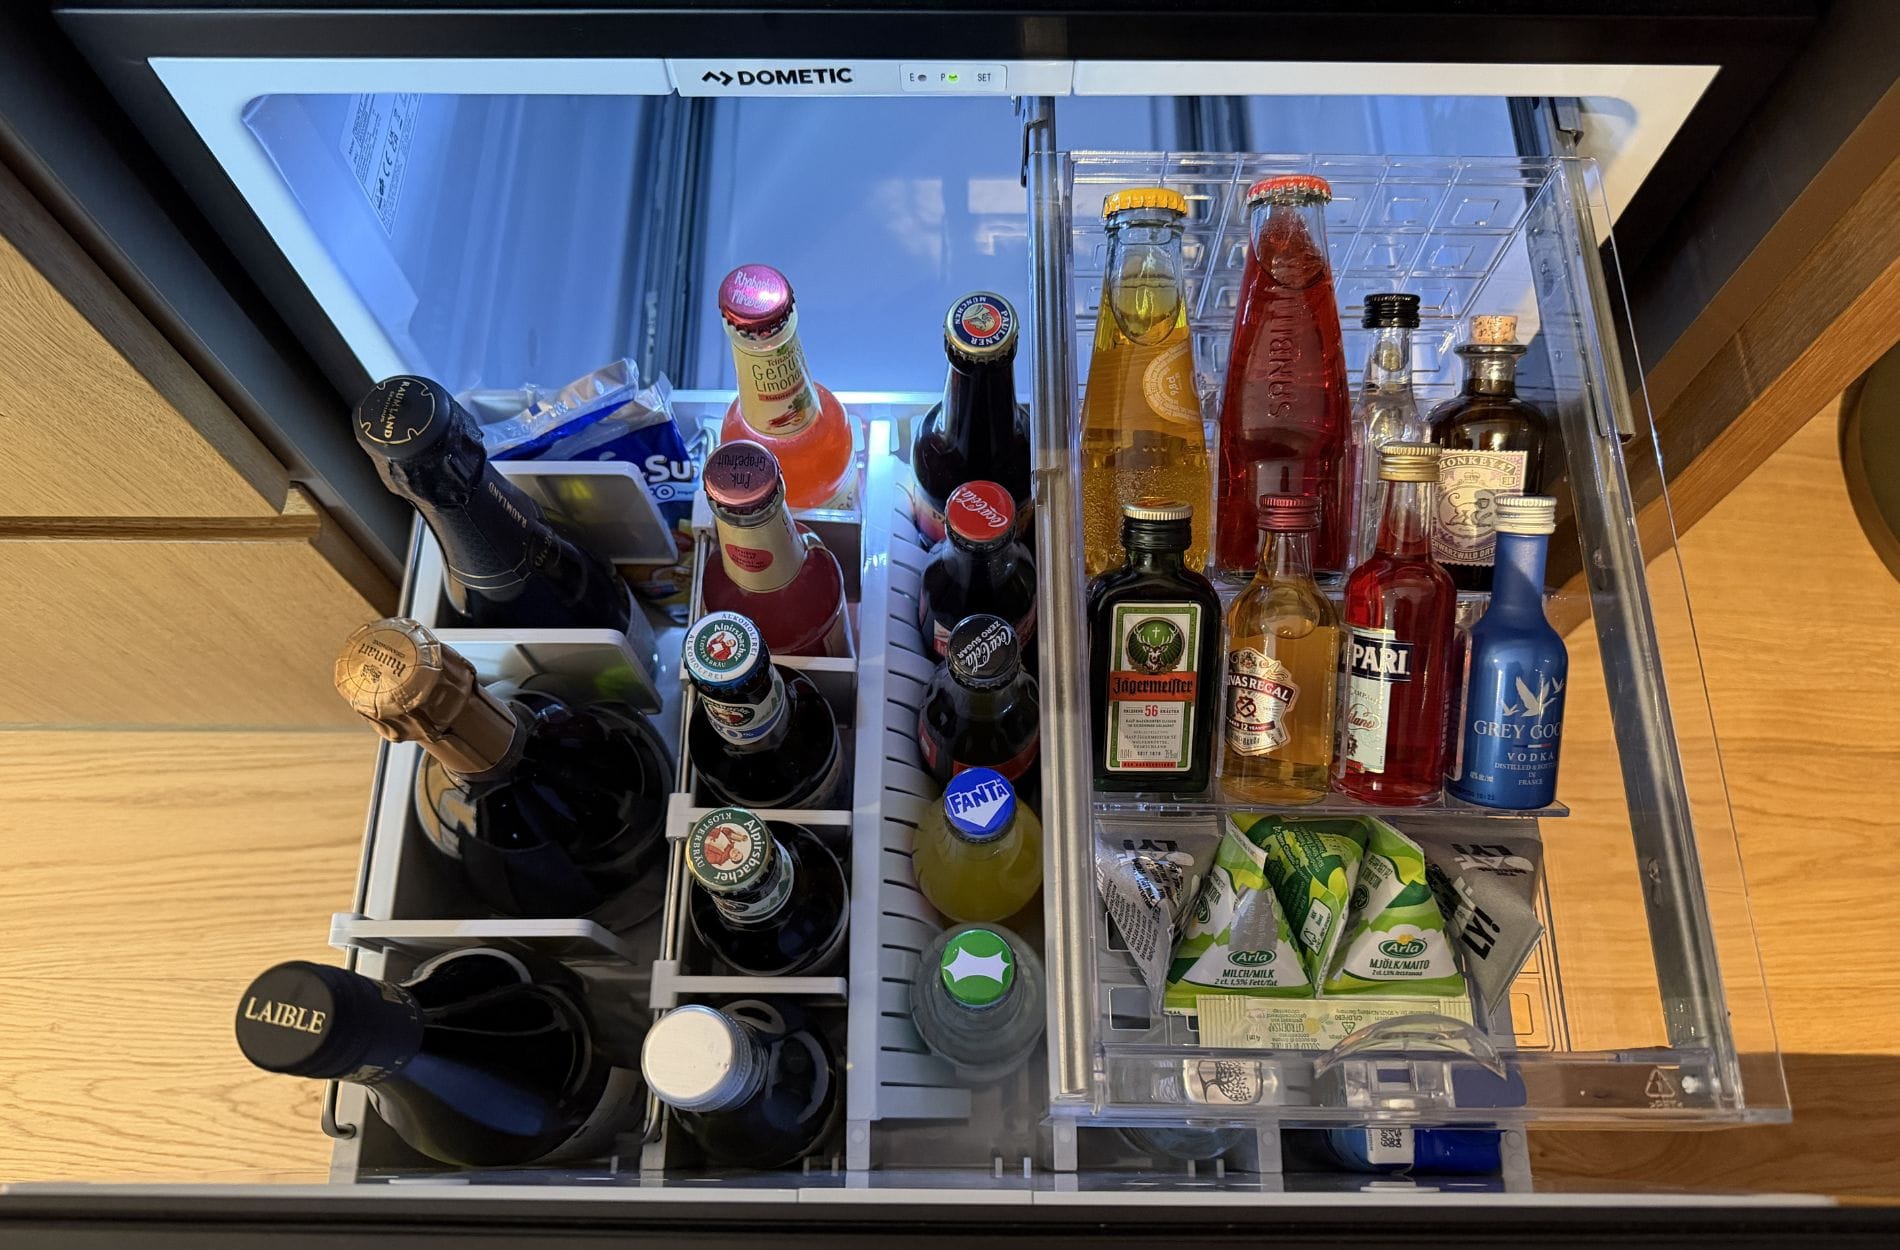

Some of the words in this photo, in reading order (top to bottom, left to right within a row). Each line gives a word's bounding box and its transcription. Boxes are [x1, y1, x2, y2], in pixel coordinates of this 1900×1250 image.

[738, 68, 854, 86] DOMETIC
[909, 72, 915, 82] E
[940, 72, 946, 82] P
[976, 72, 992, 82] SET
[970, 310, 1010, 346] PAULANER
[384, 381, 411, 439] RAUMLAND
[717, 454, 767, 472] Grapefruit
[1439, 455, 1498, 469] MONKEY
[1499, 460, 1516, 474] 47
[730, 472, 752, 489] Pink
[488, 481, 528, 529] RAUMLAND
[955, 489, 1009, 528] Coca-Cola
[1432, 541, 1479, 560] CHWARZWALD
[721, 612, 760, 658] ALKOHOLFREI
[980, 620, 1001, 638] ZERO
[713, 622, 747, 662] Alpirsbacher
[956, 636, 982, 659] SUGAR
[965, 625, 1012, 676] Coca-Cola
[358, 643, 407, 678] Ruinart
[685, 634, 724, 680] ALKOHOLFREI
[1113, 676, 1193, 695] Jägermeister
[1249, 678, 1290, 702] REGAL
[1144, 704, 1159, 717] 56
[1241, 721, 1248, 731] 12
[1473, 719, 1526, 739] GREY
[1507, 751, 1555, 762] VODKA
[948, 780, 1010, 815] FANTA
[713, 819, 766, 883] Alpirsbacher
[1461, 905, 1501, 961] LY!
[1236, 951, 1269, 962] Arla
[1387, 942, 1420, 953] Arla
[1222, 968, 1276, 979] MILCH/MILK
[1369, 958, 1430, 970] MJÖLK/MAITO
[244, 996, 327, 1036] LAIBLE
